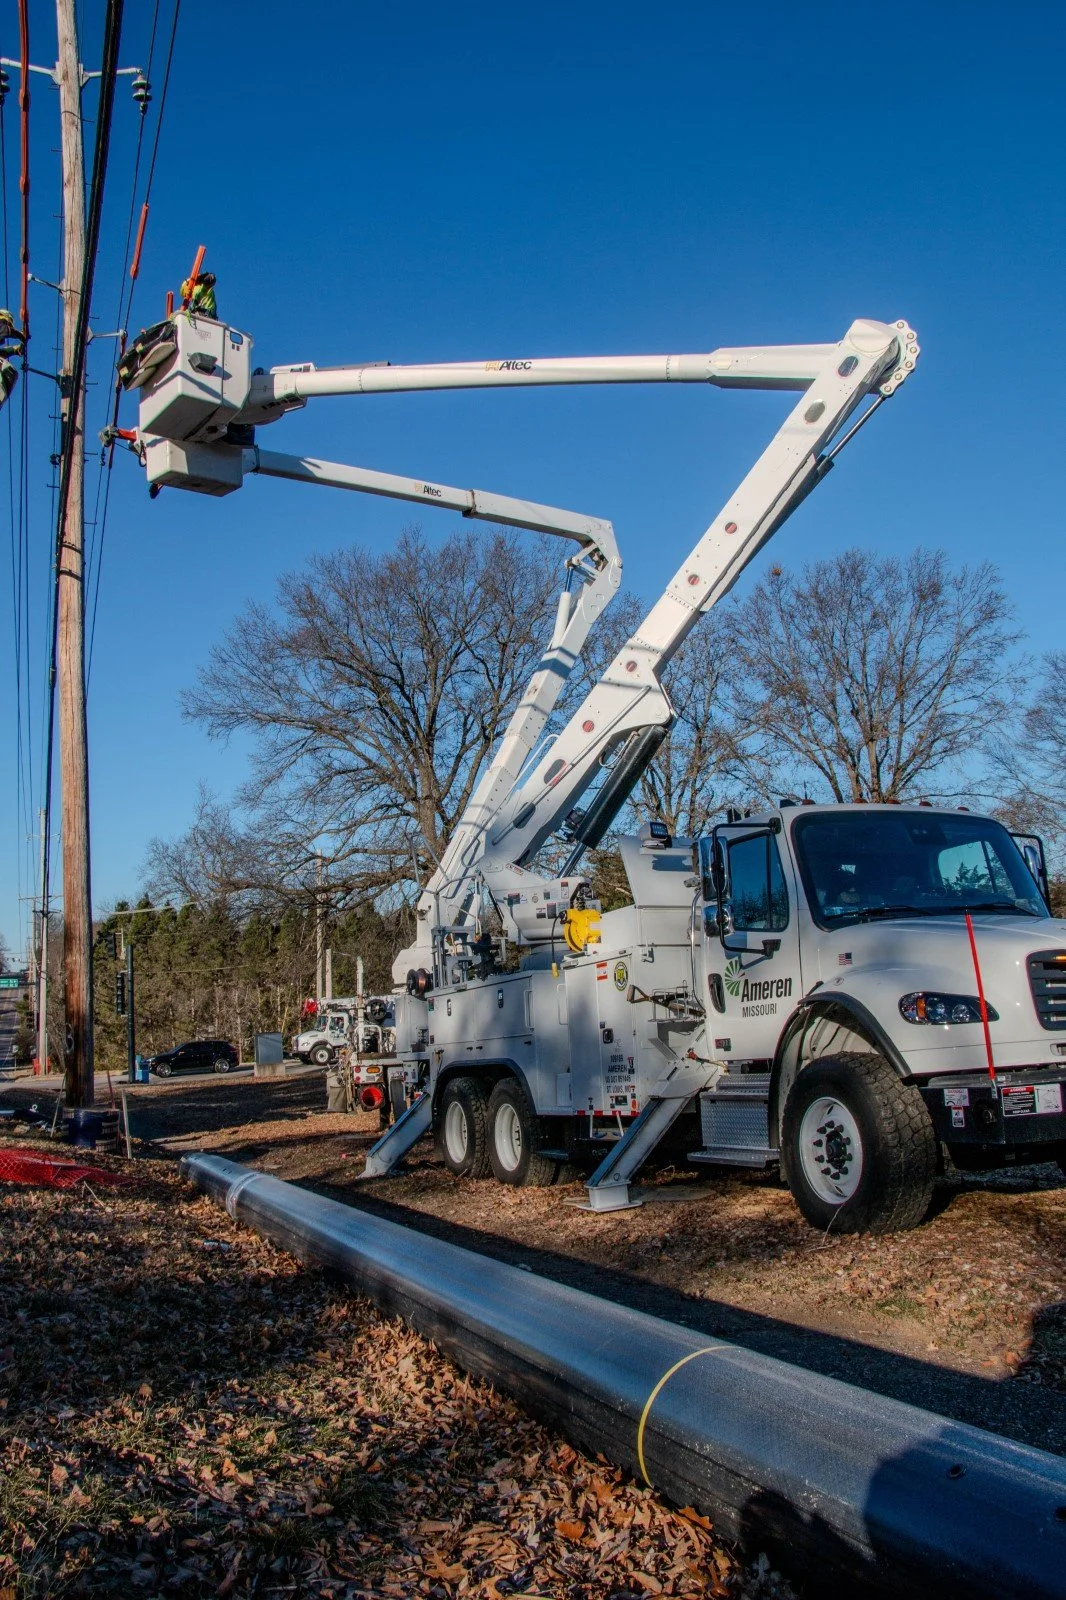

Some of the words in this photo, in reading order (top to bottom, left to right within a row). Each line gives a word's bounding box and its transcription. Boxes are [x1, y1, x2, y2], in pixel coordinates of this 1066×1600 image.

[499, 360, 532, 371] Altec
[423, 484, 442, 498] Altec
[740, 977, 793, 1003] Ameren
[742, 1003, 777, 1018] MISSOURI
[608, 1064, 628, 1073] AMEREN
